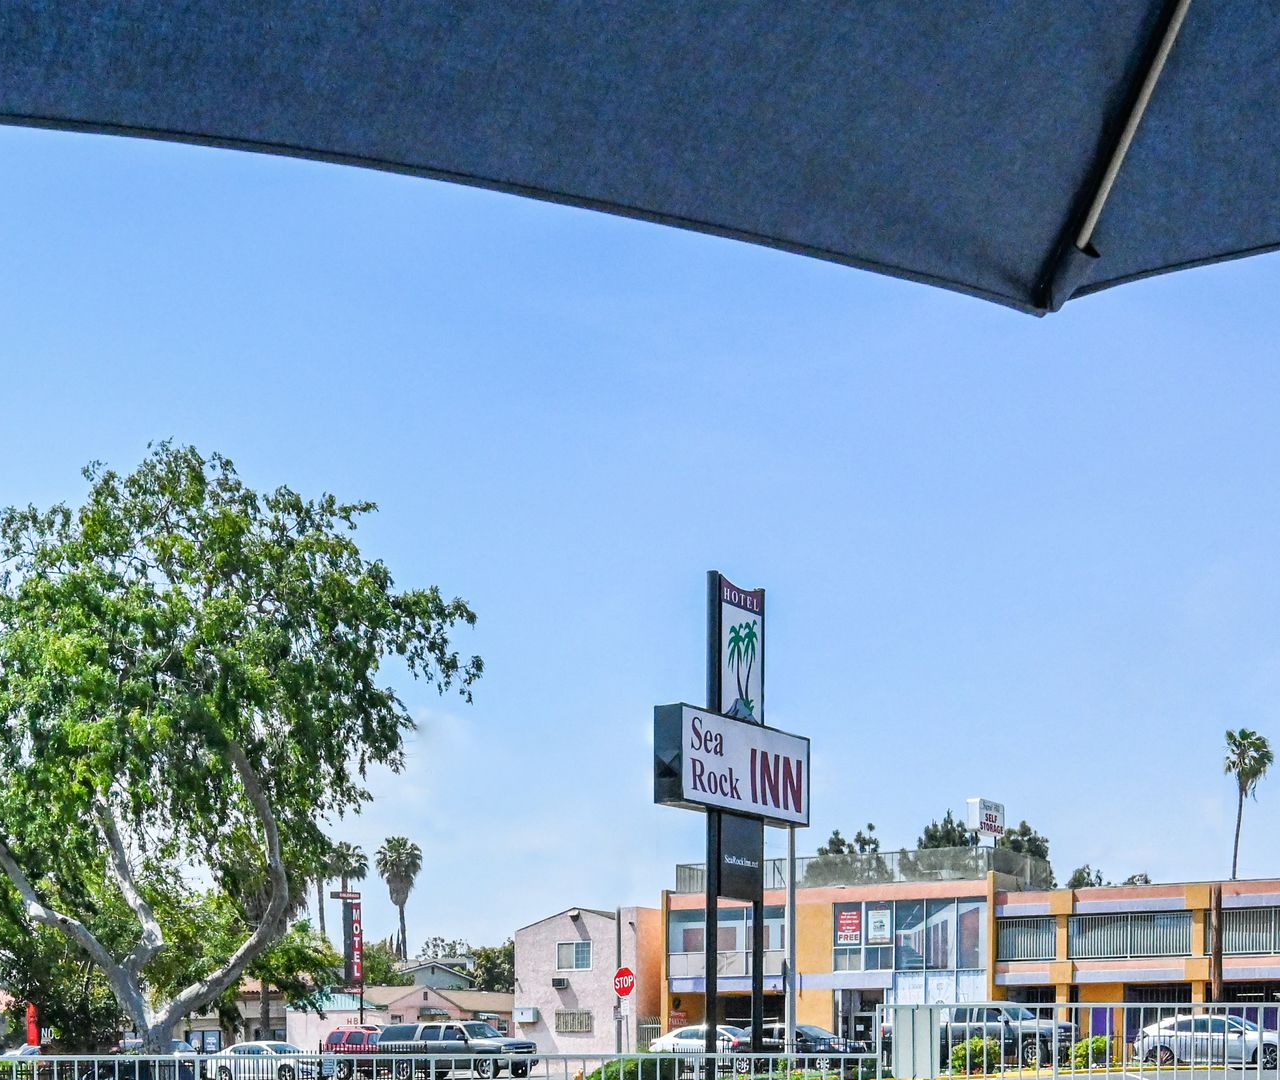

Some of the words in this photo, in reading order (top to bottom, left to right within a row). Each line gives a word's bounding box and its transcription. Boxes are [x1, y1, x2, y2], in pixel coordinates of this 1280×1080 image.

[723, 587, 759, 611] HOTEL
[691, 716, 724, 757] Sea
[690, 757, 742, 801] Rock
[750, 748, 802, 814] INN
[980, 821, 1004, 835] STORAGE
[985, 813, 997, 824] SELF
[352, 908, 361, 977] MOTEL
[838, 933, 859, 942] FREE
[615, 975, 633, 989] STOP
[346, 1017, 364, 1025] HB
